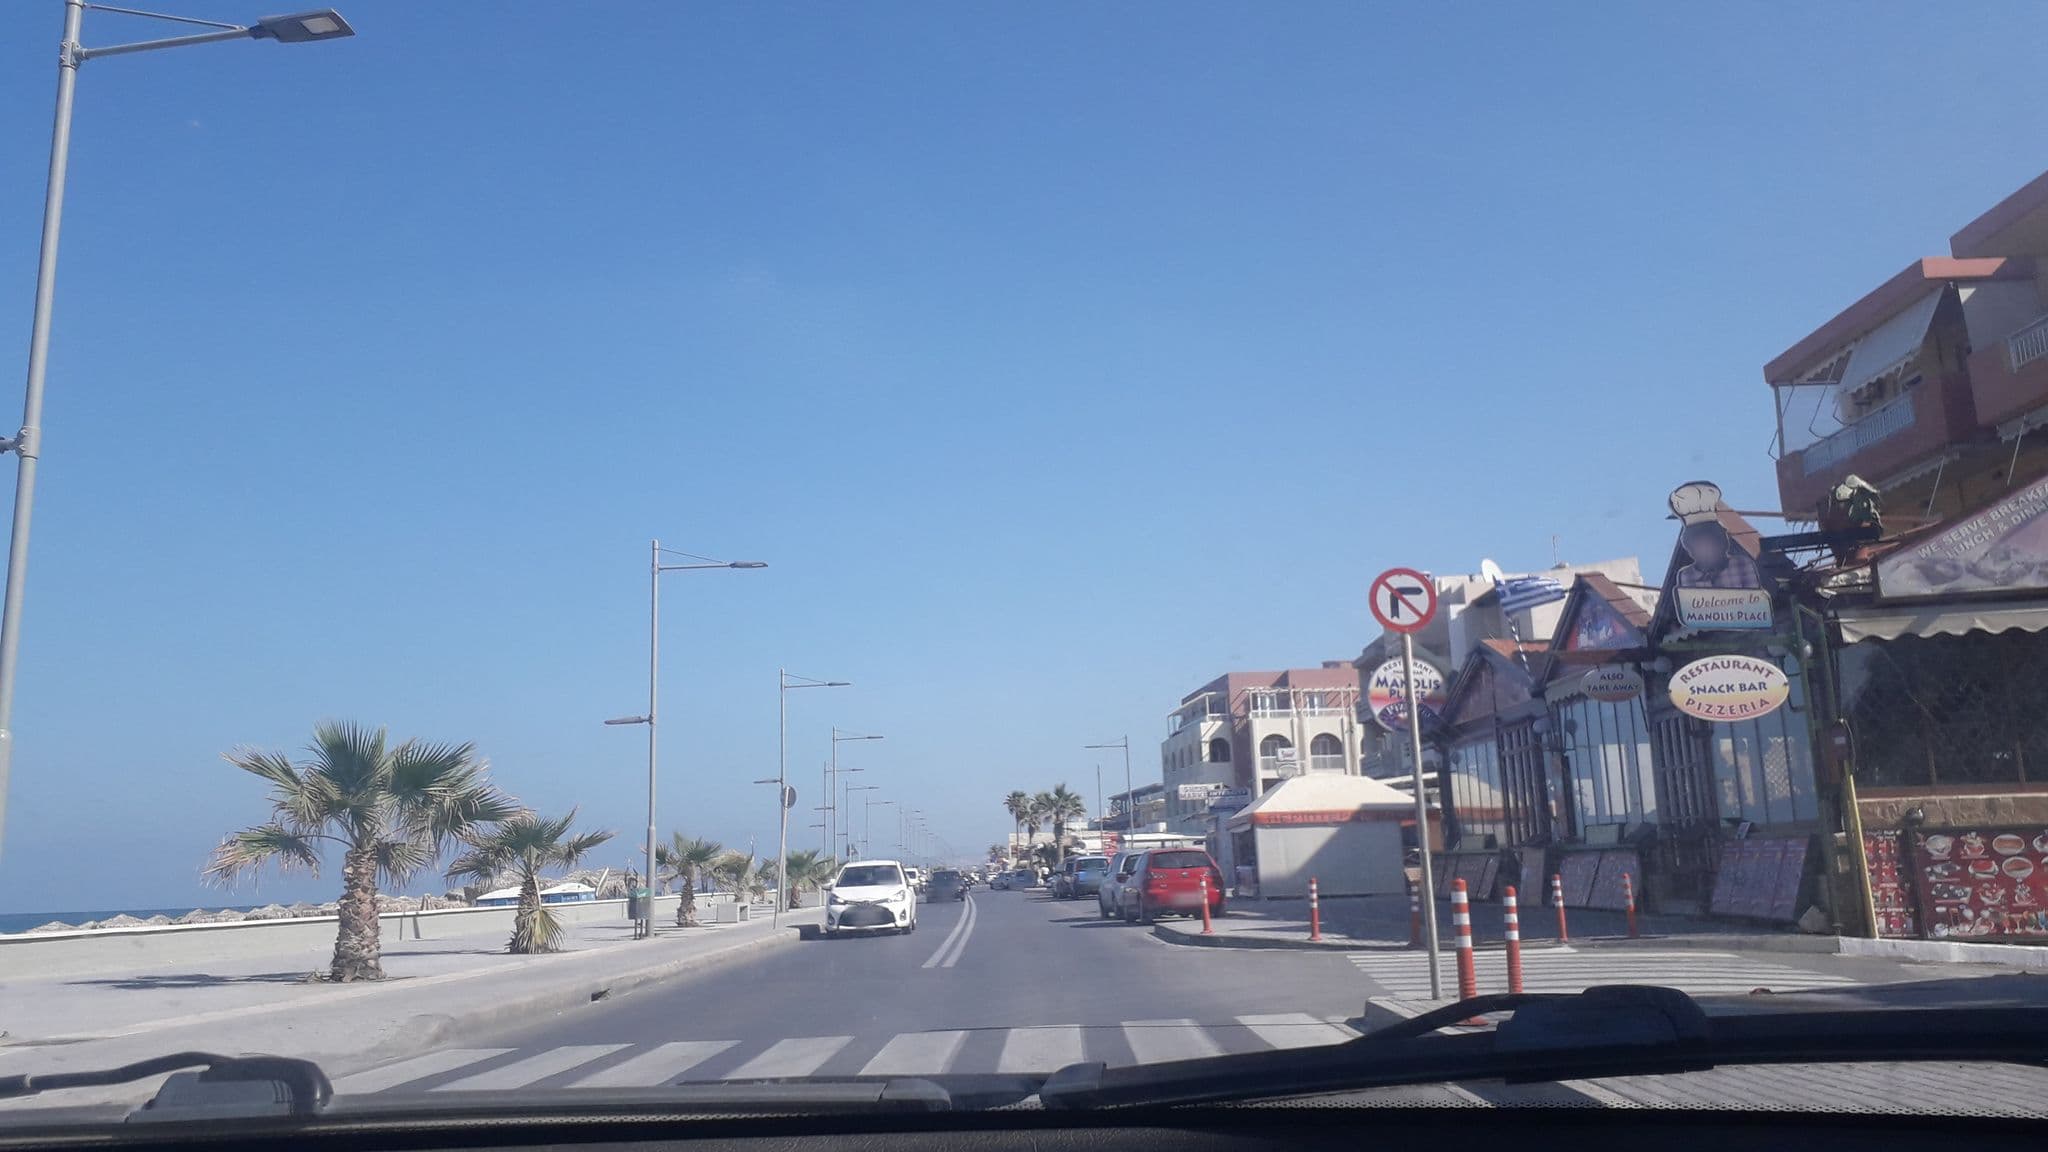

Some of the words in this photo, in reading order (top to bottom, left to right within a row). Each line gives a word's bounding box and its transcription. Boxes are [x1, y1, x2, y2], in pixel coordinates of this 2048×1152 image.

[1918, 543, 1940, 560] WE
[1942, 517, 1989, 547] SERVE
[1945, 529, 1995, 560] LUNCH
[1691, 595, 1744, 609] Welcome
[1749, 593, 1760, 603] to
[1686, 611, 1734, 621] MANOLIS
[1737, 611, 1767, 620] PLACE
[1383, 661, 1433, 674] RESTRANT
[1680, 660, 1774, 684] RESTAURANT
[1689, 683, 1735, 695] SNACK
[1739, 681, 1768, 692] BAR
[1685, 698, 1770, 715] PIZZERIA
